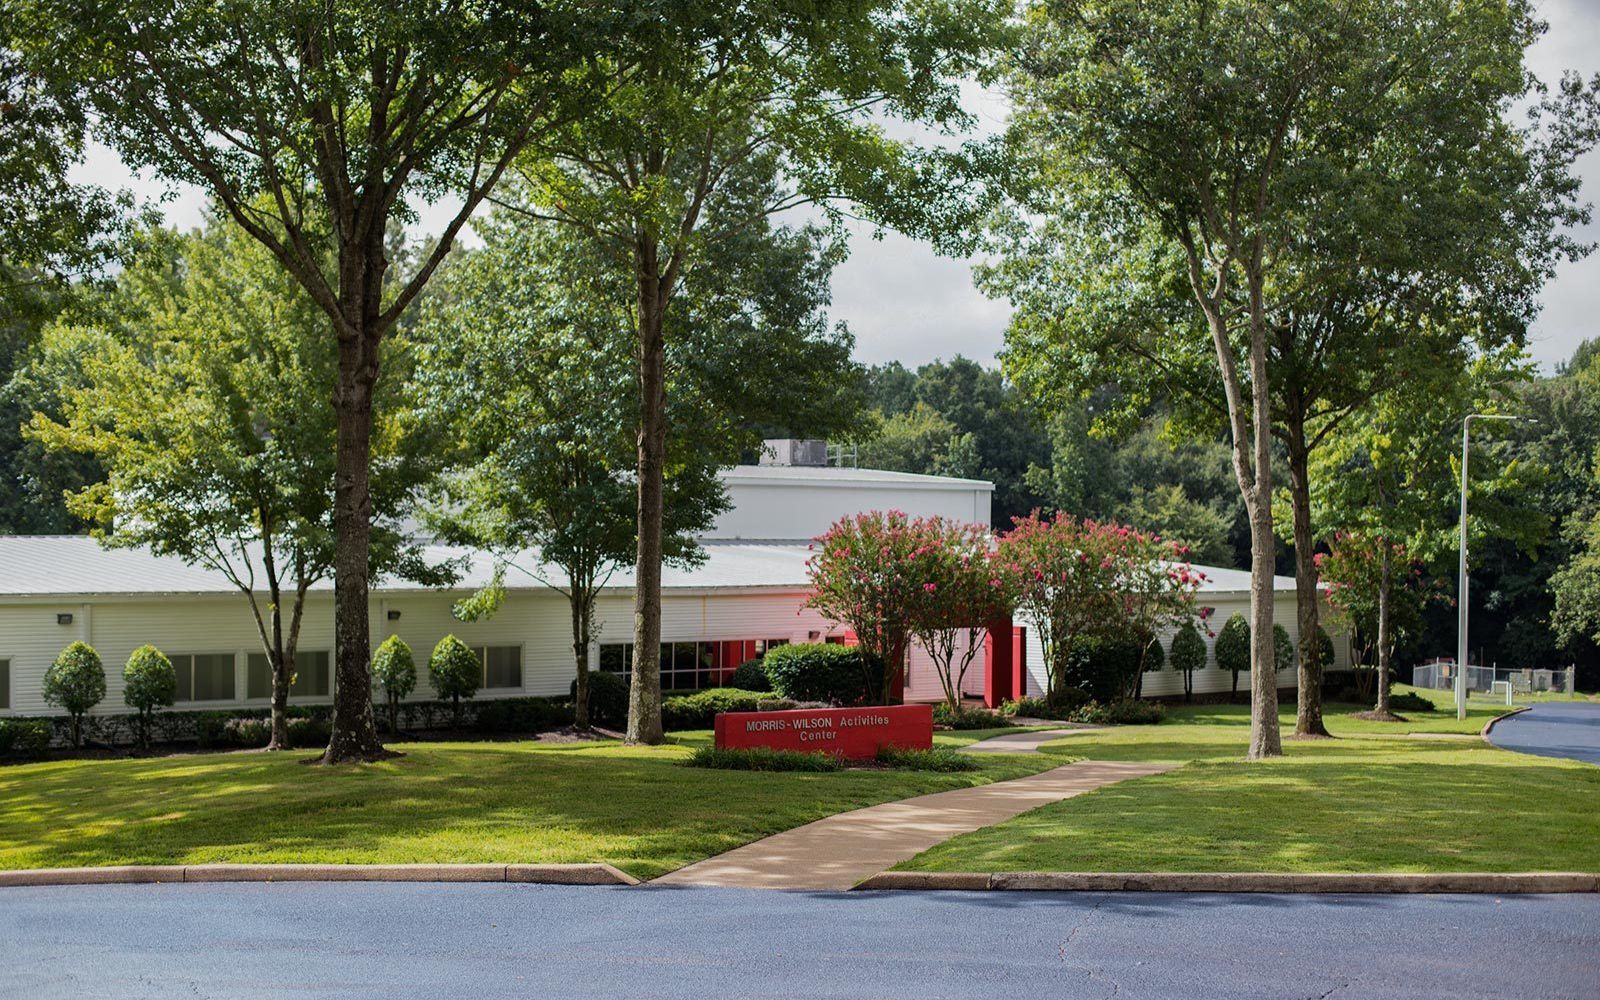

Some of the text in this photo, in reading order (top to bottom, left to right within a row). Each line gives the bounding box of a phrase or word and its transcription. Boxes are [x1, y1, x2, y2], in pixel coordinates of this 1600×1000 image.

[746, 714, 890, 731] MORRIS-WILSON Activities
[800, 730, 837, 741] Center
